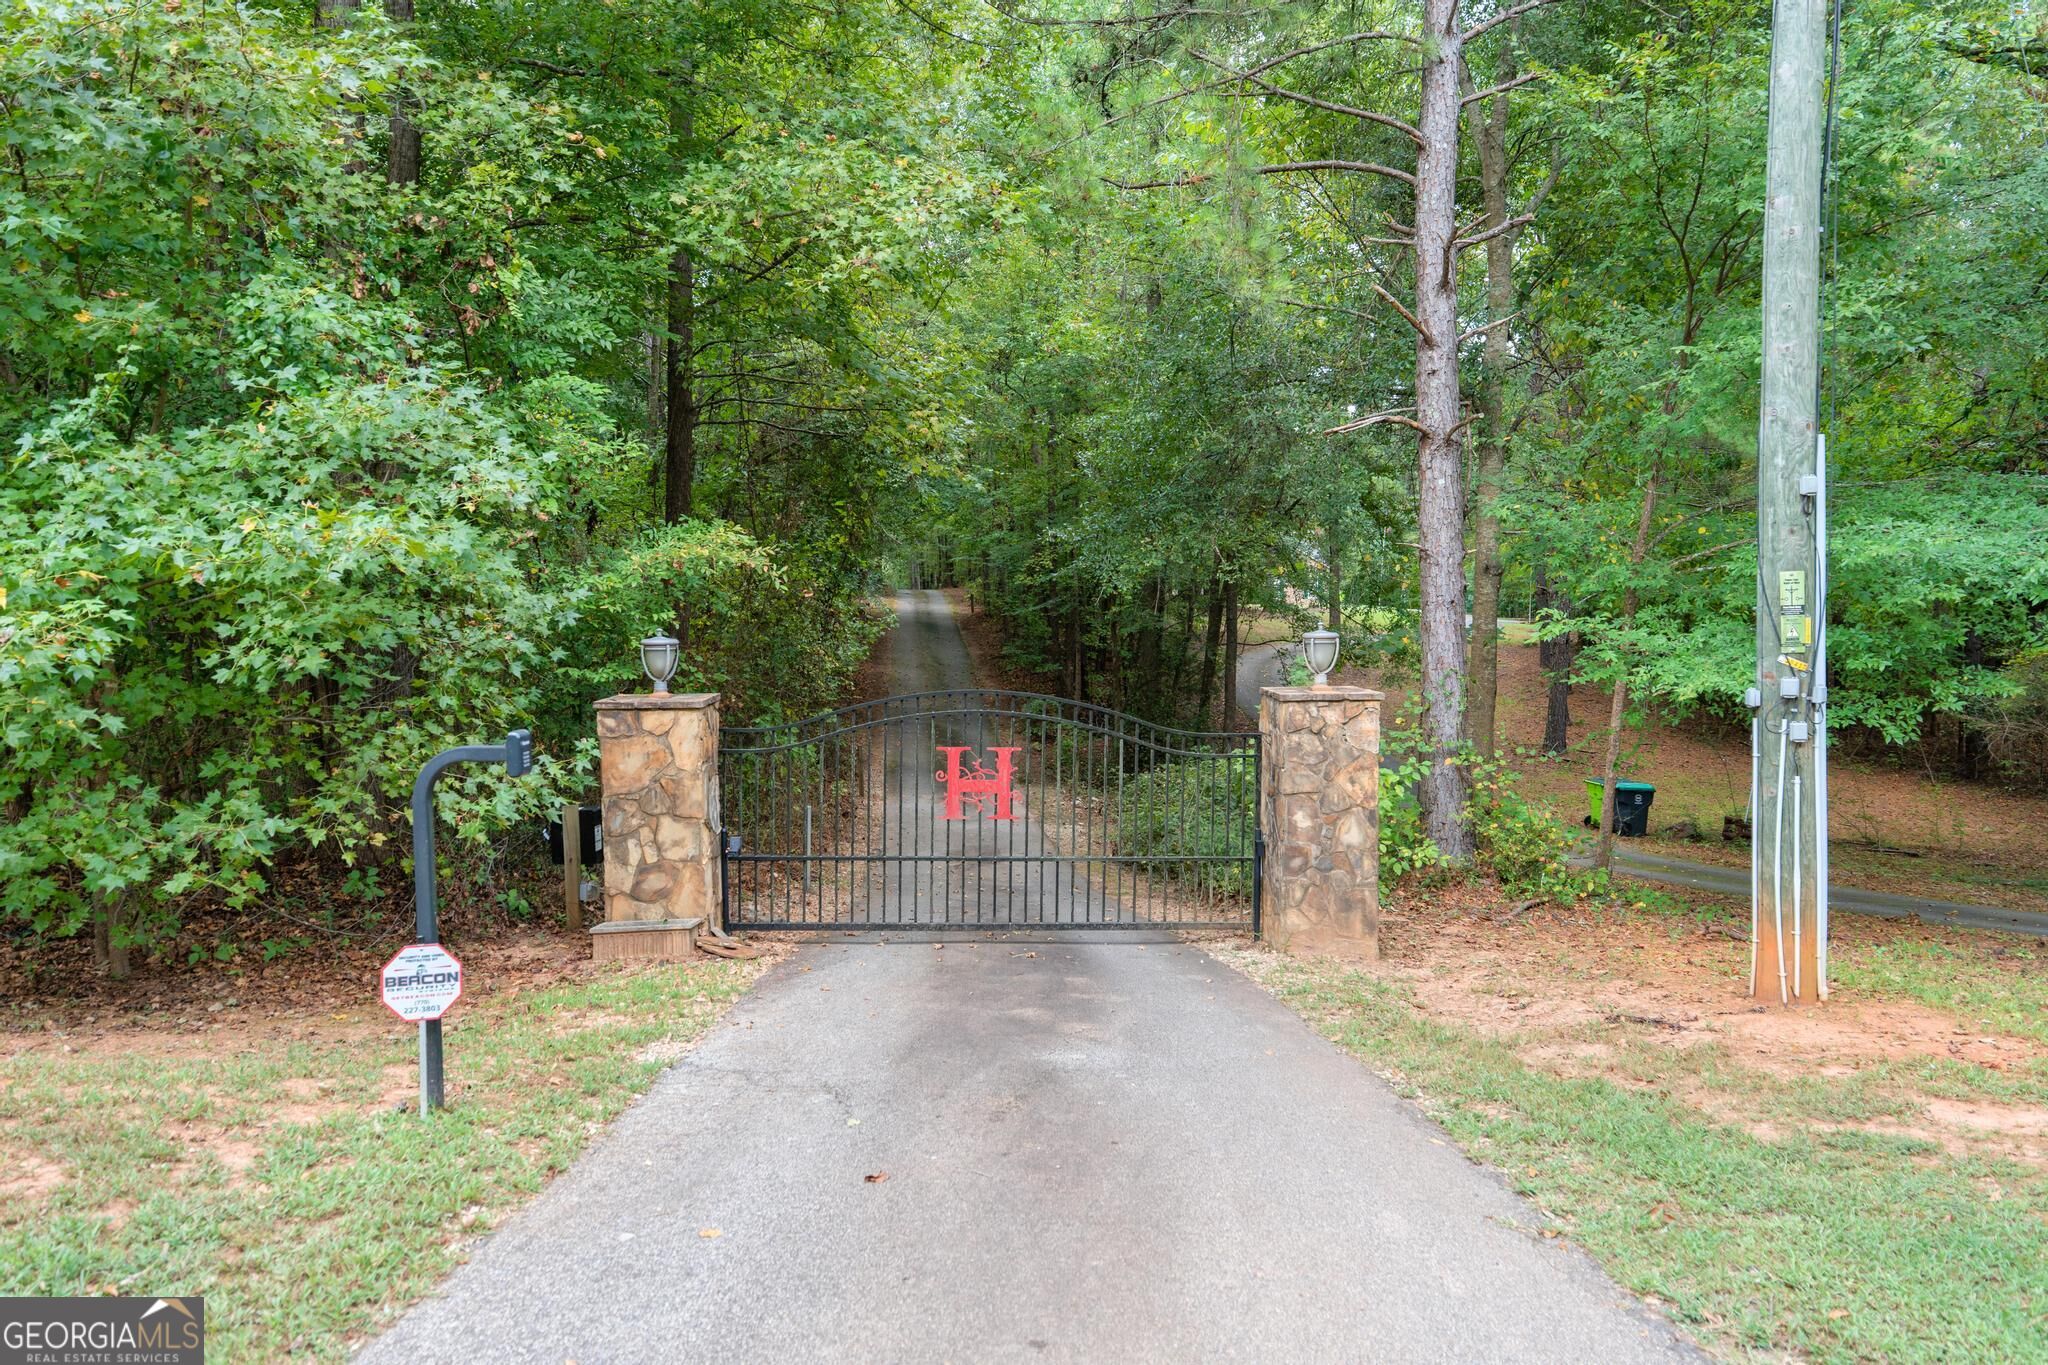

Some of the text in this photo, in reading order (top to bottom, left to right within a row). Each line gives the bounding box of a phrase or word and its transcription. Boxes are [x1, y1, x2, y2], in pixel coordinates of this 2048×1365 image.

[935, 746, 1022, 820] H
[385, 971, 459, 988] BEACON
[386, 983, 456, 992] SECURITY
